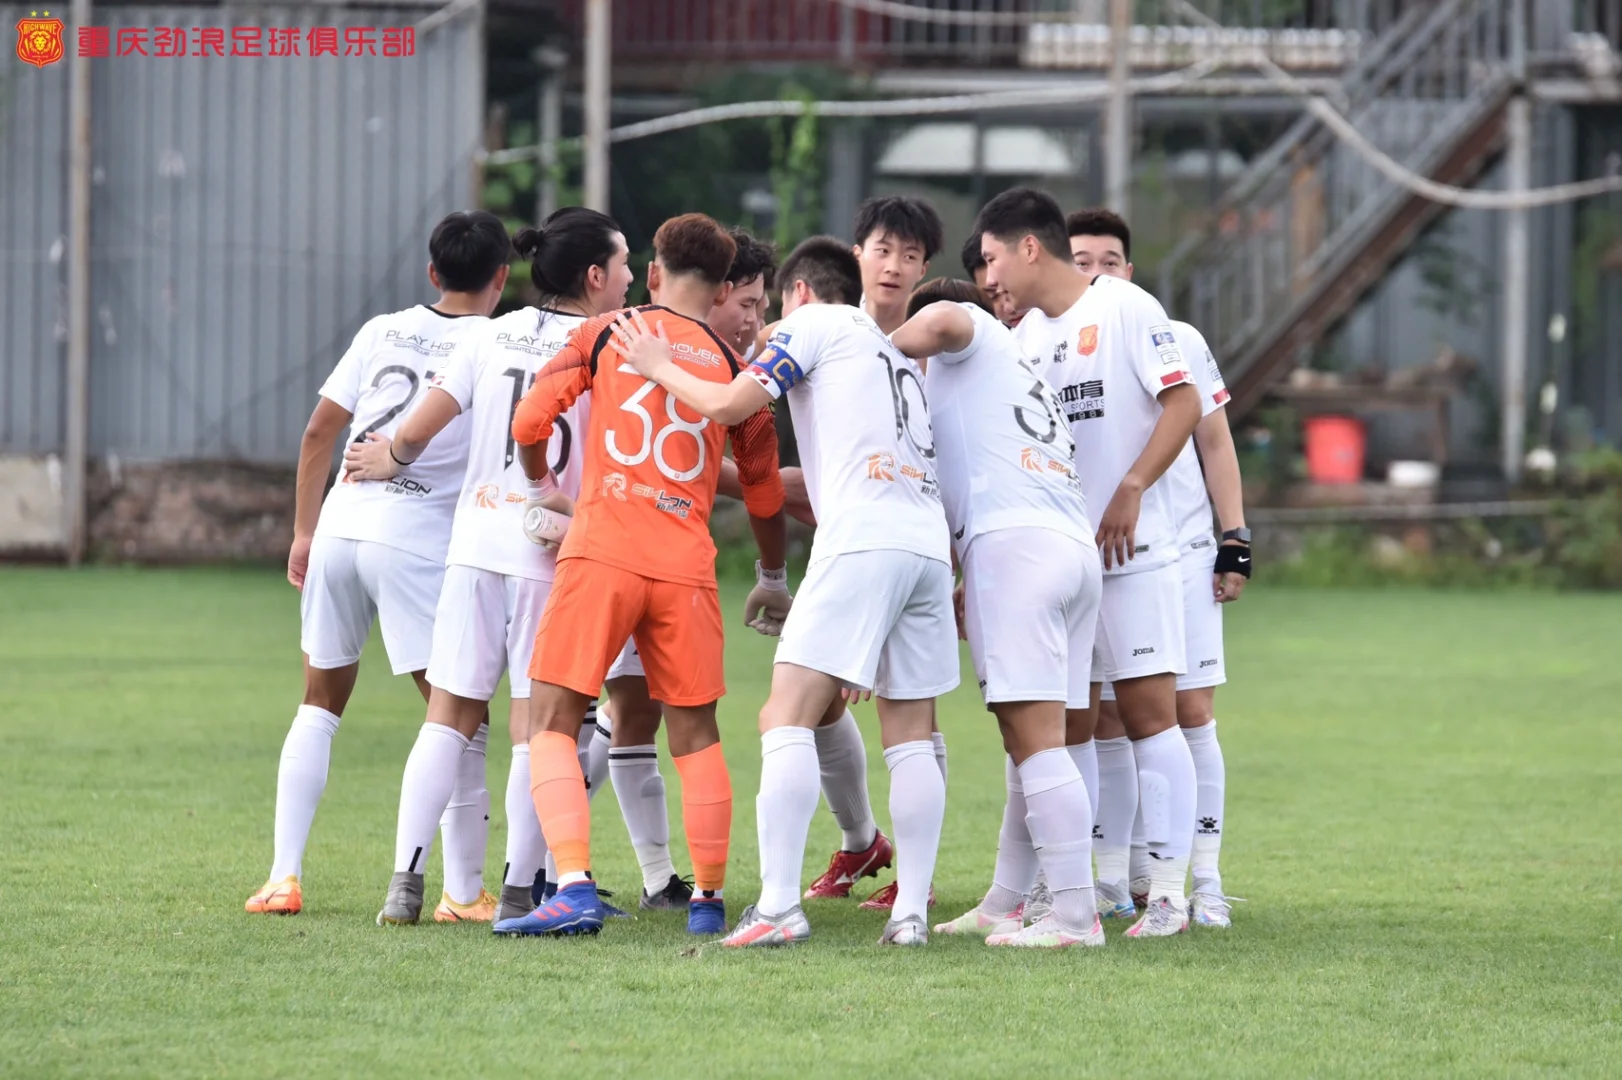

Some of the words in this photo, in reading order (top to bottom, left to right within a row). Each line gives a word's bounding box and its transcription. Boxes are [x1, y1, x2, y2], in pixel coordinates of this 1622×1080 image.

[385, 330, 428, 345] PLAY
[496, 332, 539, 346] PLAY
[772, 357, 796, 382] C
[1058, 379, 1104, 404] 体育
[877, 350, 937, 459] 10
[604, 363, 710, 482] 38
